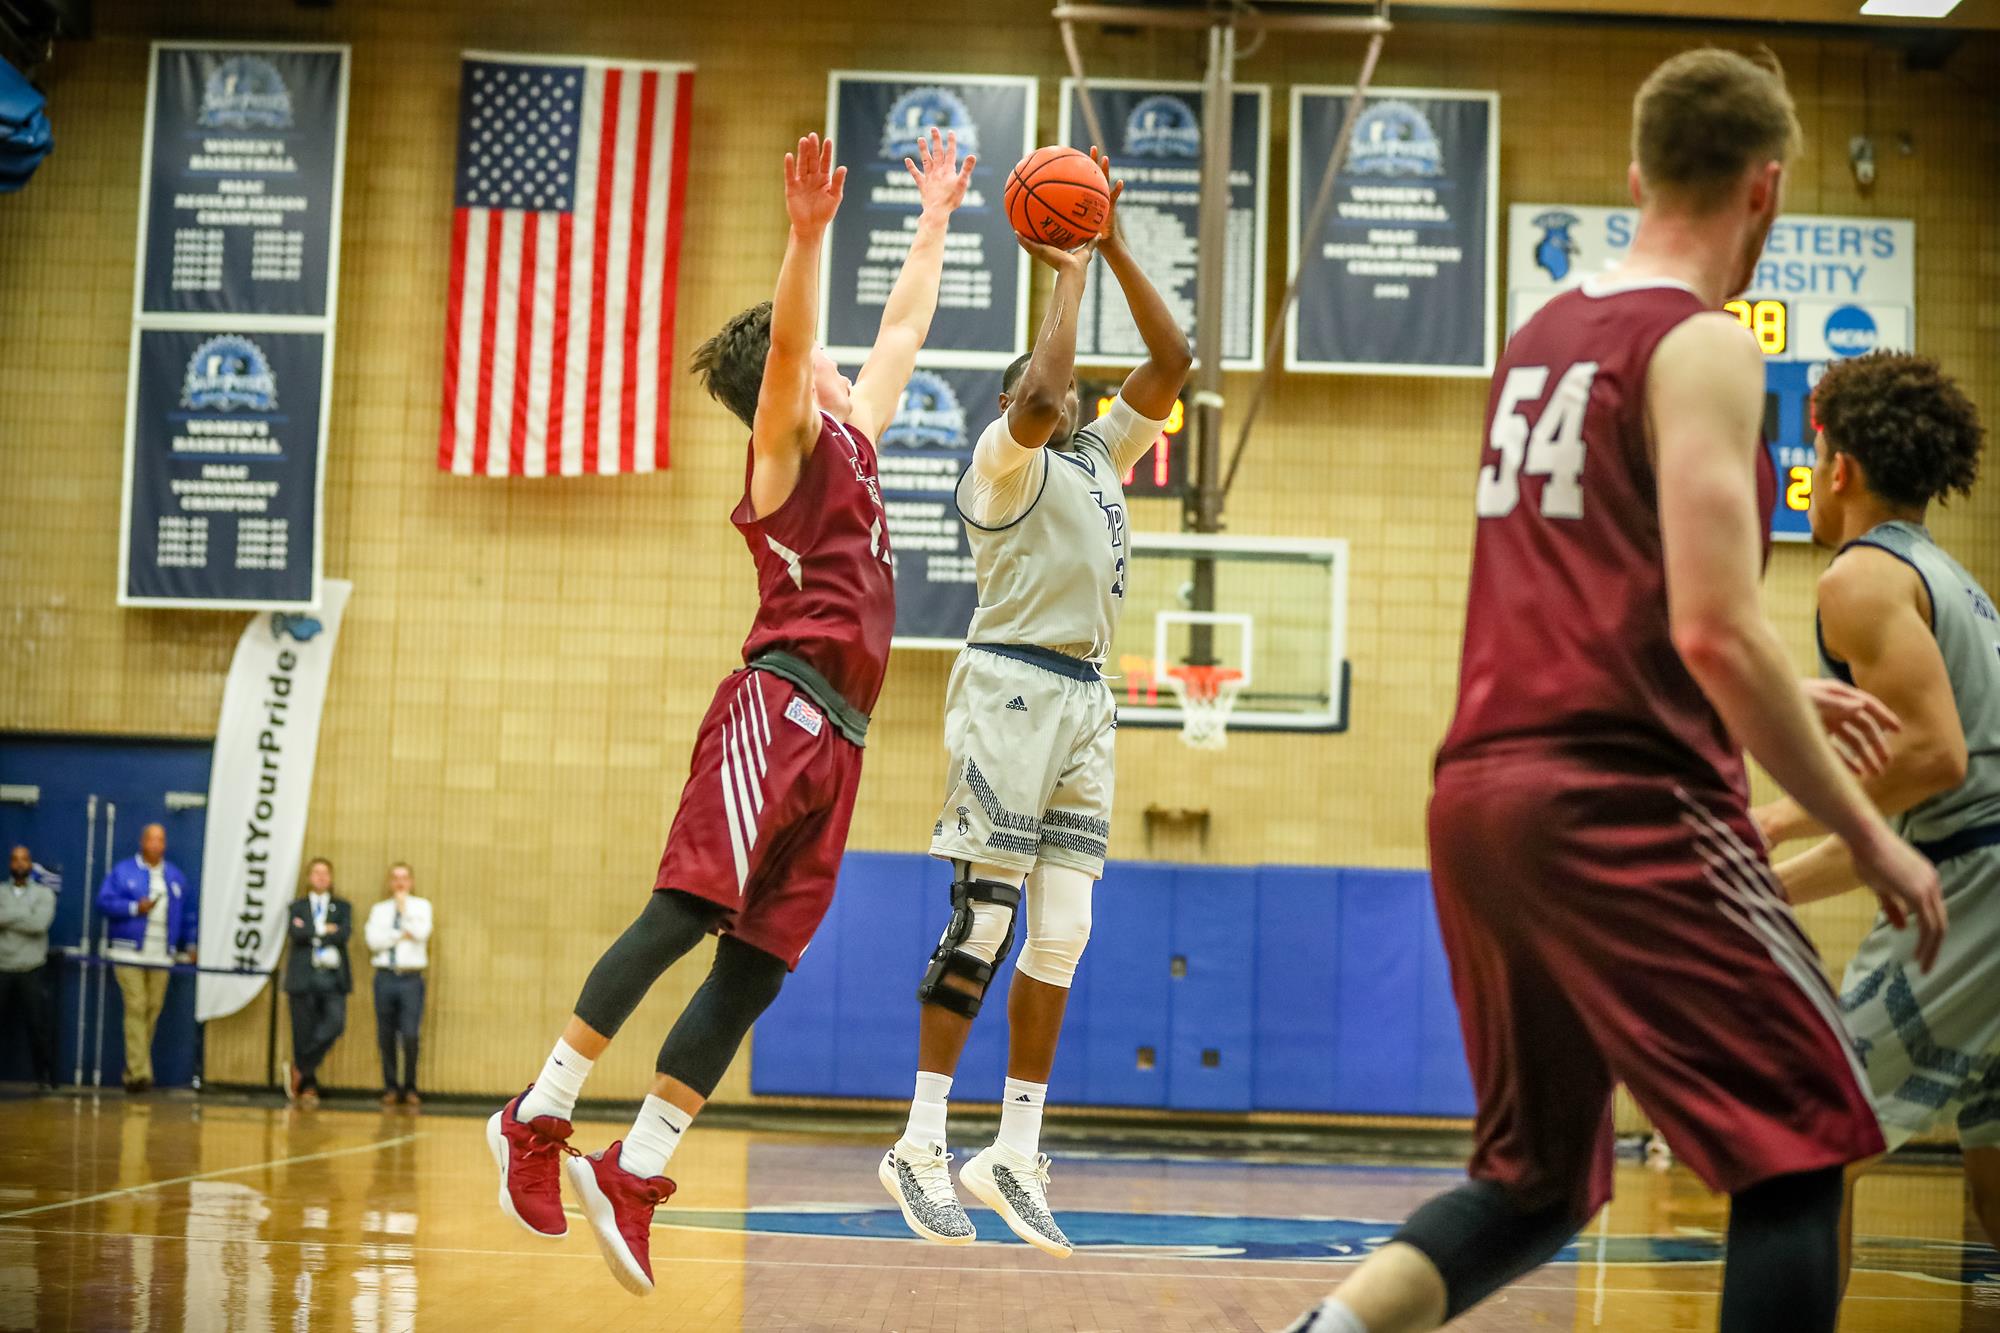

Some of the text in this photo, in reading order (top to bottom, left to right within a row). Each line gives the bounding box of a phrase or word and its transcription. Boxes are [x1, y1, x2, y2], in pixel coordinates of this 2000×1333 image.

[1766, 224, 1896, 258] ETER'S
[1477, 361, 1600, 521] 54
[1005, 703, 1028, 712] adidas
[232, 649, 299, 974] #StrutYourPride
